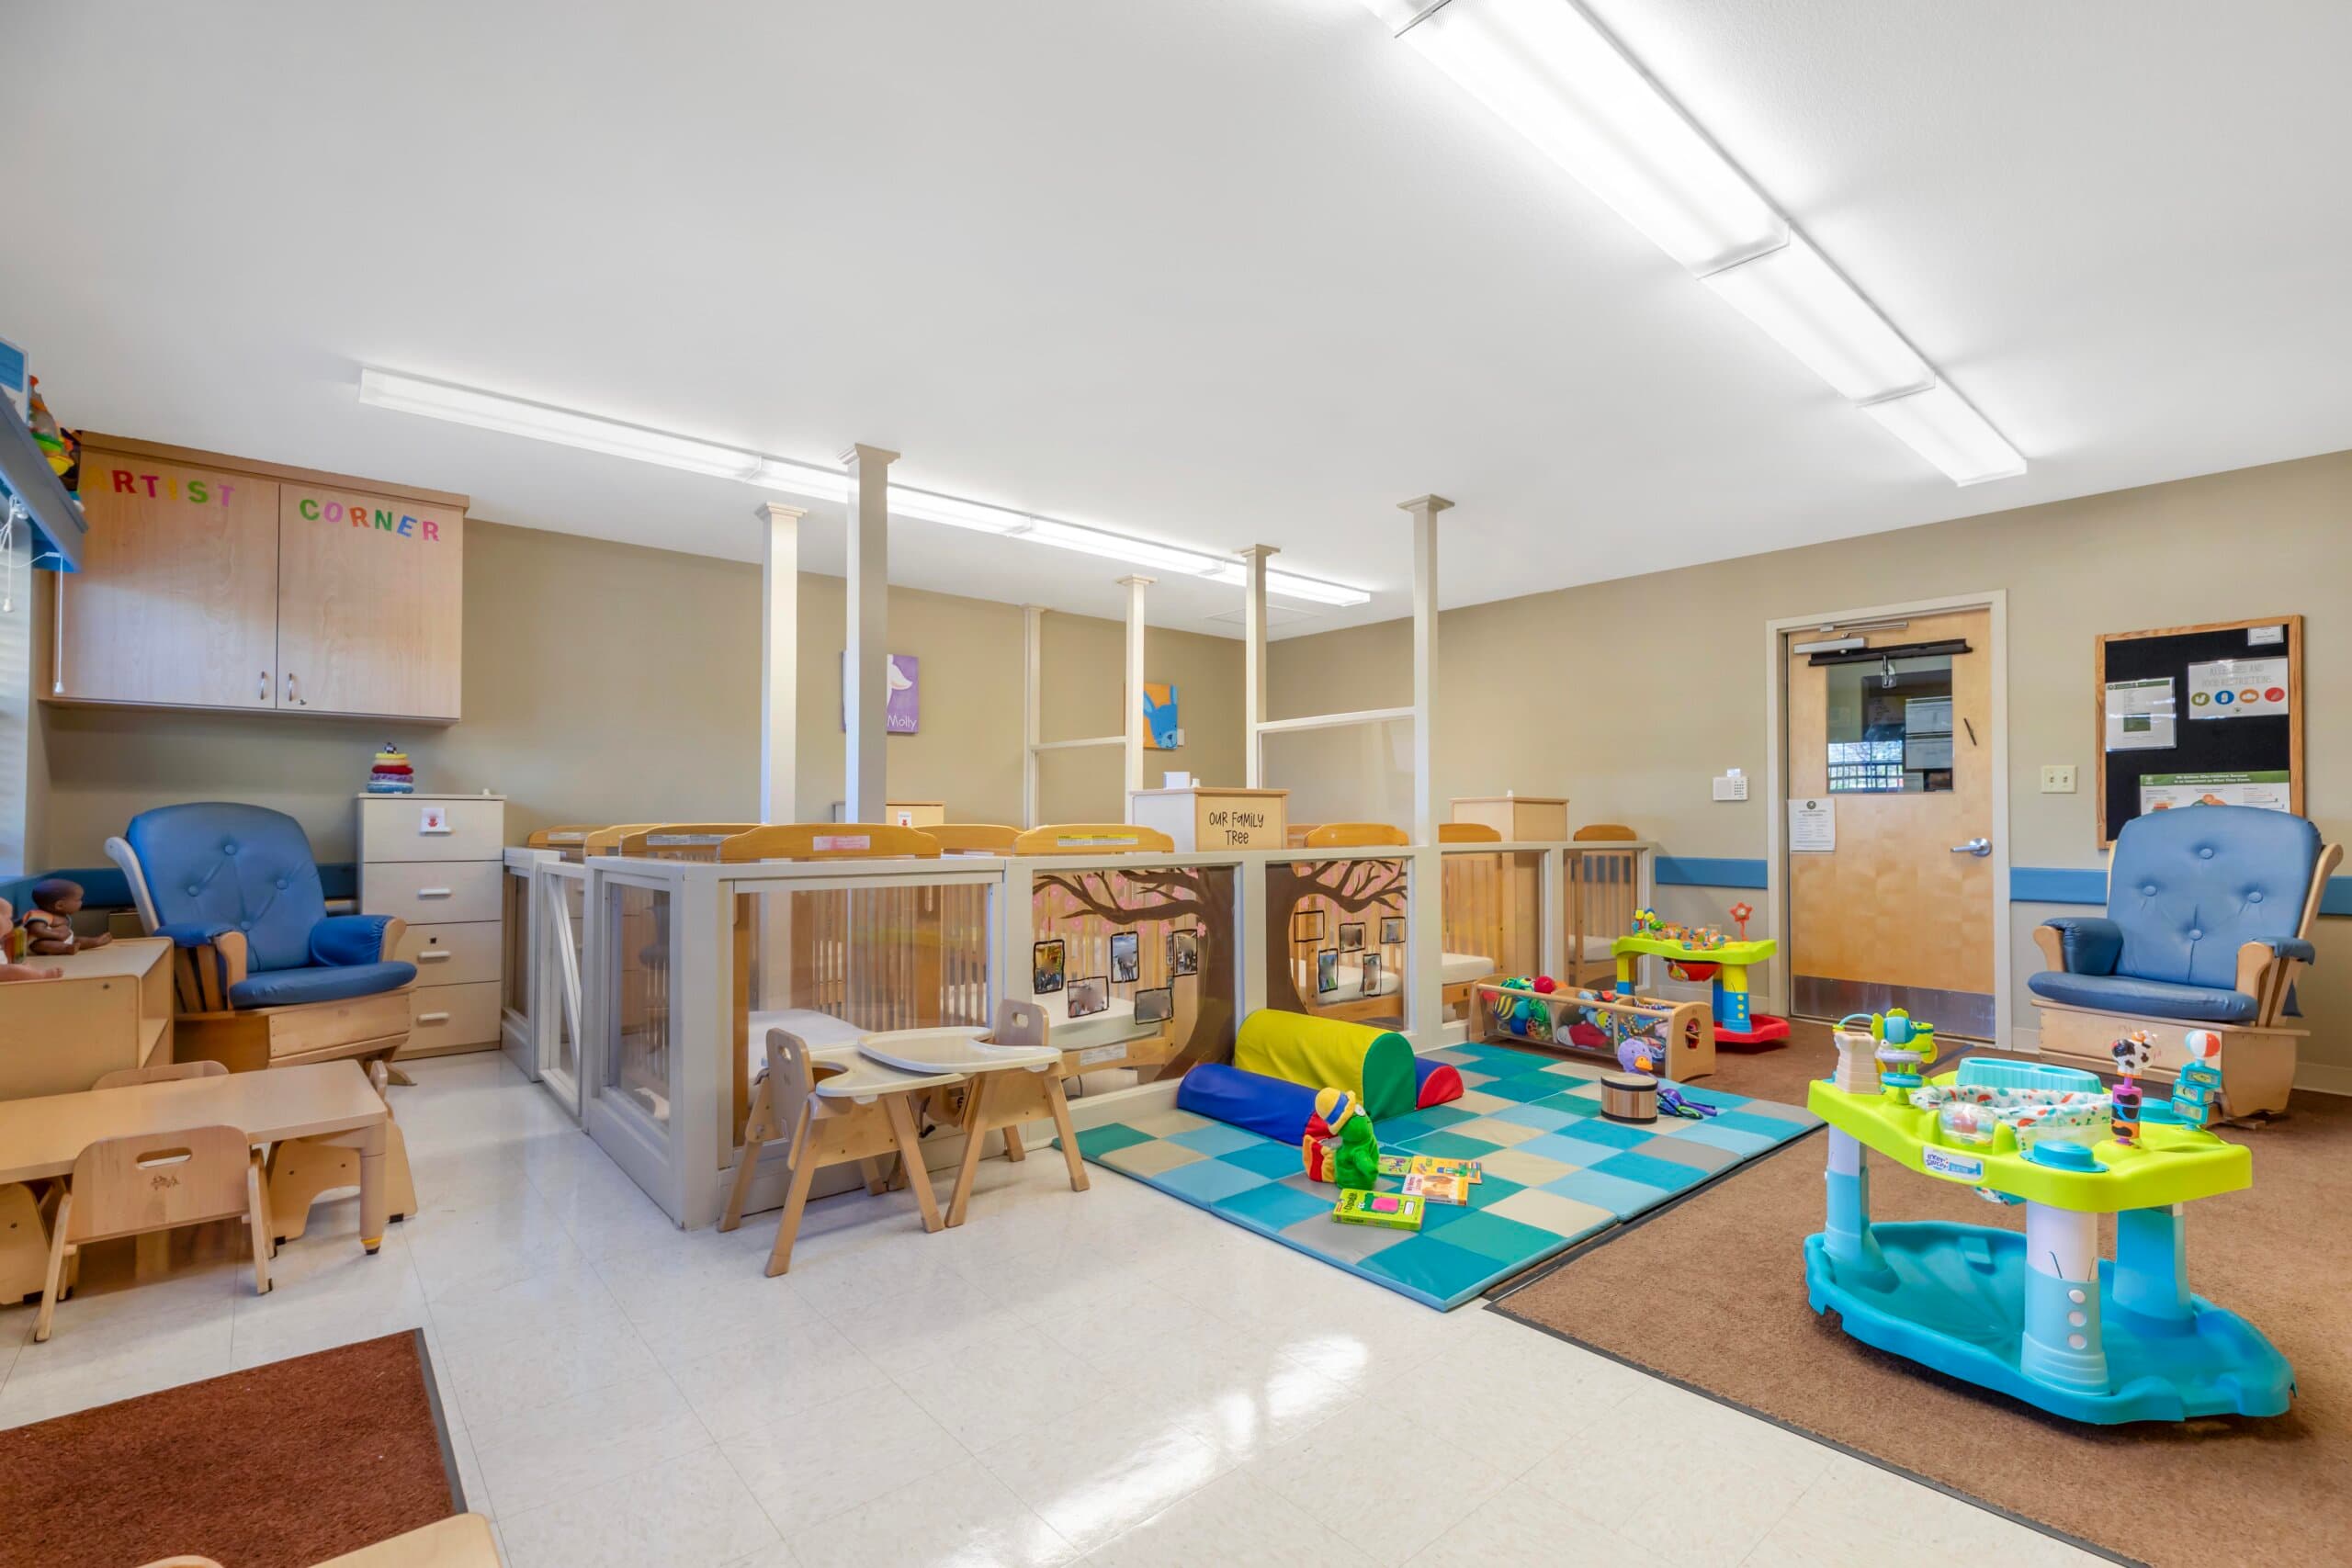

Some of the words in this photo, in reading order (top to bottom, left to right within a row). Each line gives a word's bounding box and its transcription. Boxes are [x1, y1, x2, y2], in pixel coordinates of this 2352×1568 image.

[82, 465, 235, 507] ARTIST
[300, 499, 440, 542] CORNER
[888, 714, 917, 731] Molly
